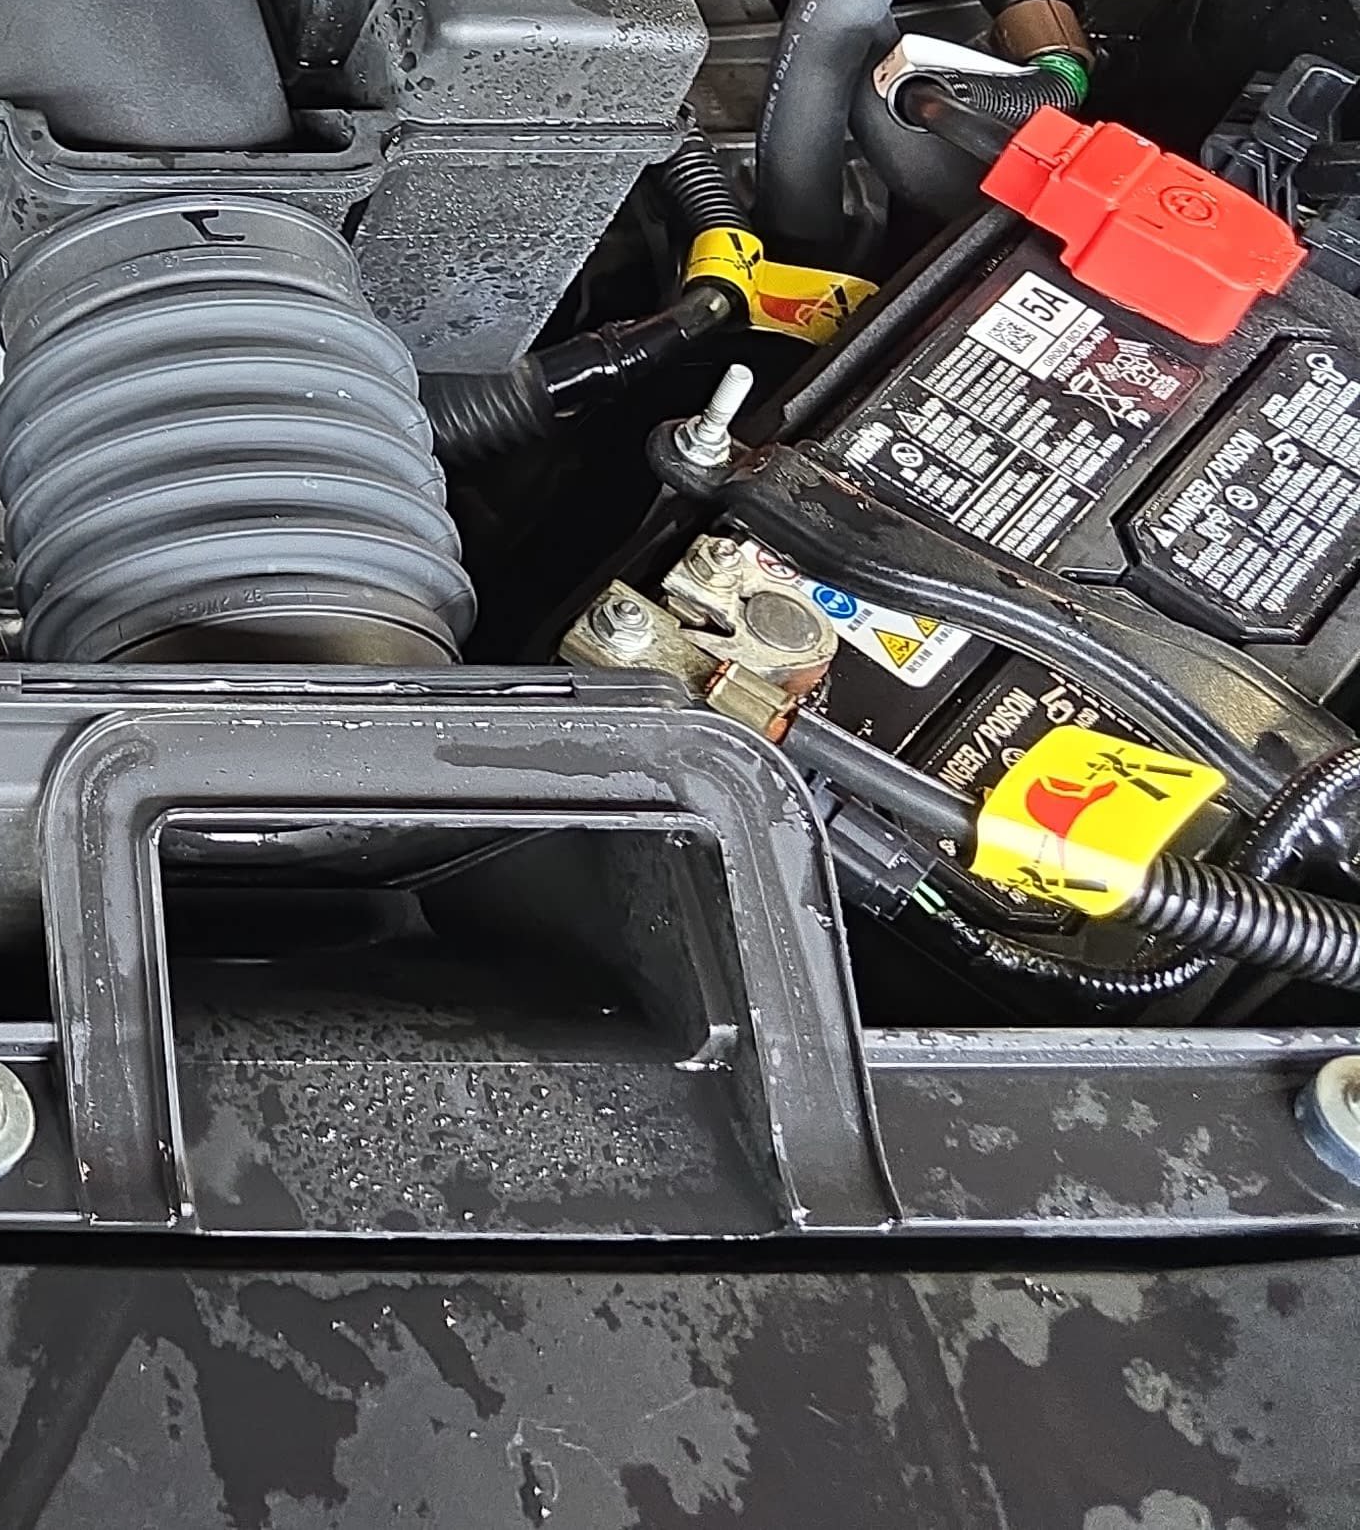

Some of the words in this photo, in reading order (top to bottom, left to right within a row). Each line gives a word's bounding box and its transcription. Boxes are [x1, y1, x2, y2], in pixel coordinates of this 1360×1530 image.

[1018, 286, 1070, 322] 5A
[1041, 339, 1070, 369] GROUP
[940, 687, 1035, 789] NGER/POISON
